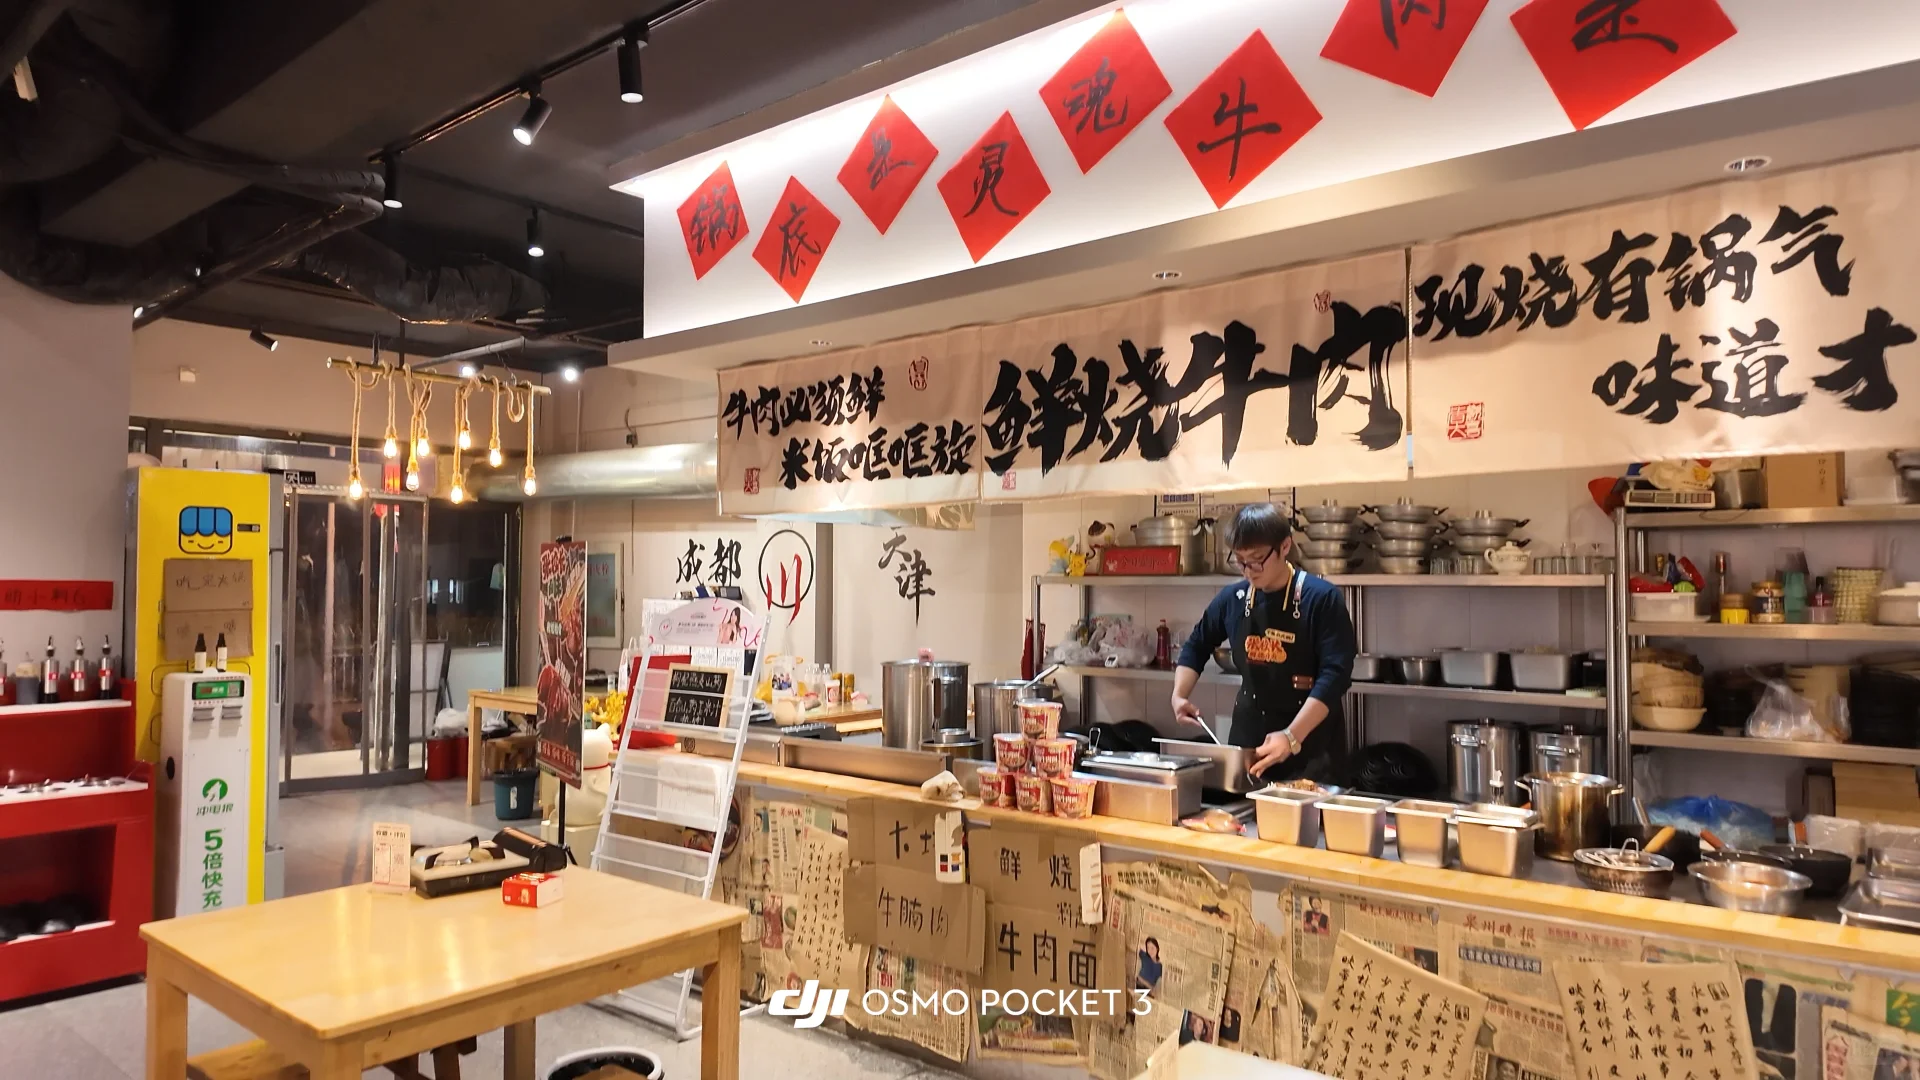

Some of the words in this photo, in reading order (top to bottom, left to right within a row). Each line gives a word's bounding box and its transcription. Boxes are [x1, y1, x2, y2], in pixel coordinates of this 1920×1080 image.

[1413, 205, 1857, 343] 现烧有锅气
[722, 365, 886, 440] 牛肉必须鲜
[983, 301, 1408, 475] 鲜烧牛肉
[1592, 307, 1918, 424] 味道才
[676, 537, 742, 586] 成都
[765, 553, 803, 628] 川
[878, 526, 936, 628] 天津
[201, 828, 224, 910] 5倍快充
[998, 846, 1077, 893] 鲜烧
[877, 886, 950, 940] 牛腩肉
[997, 920, 1099, 991] 牛肉面
